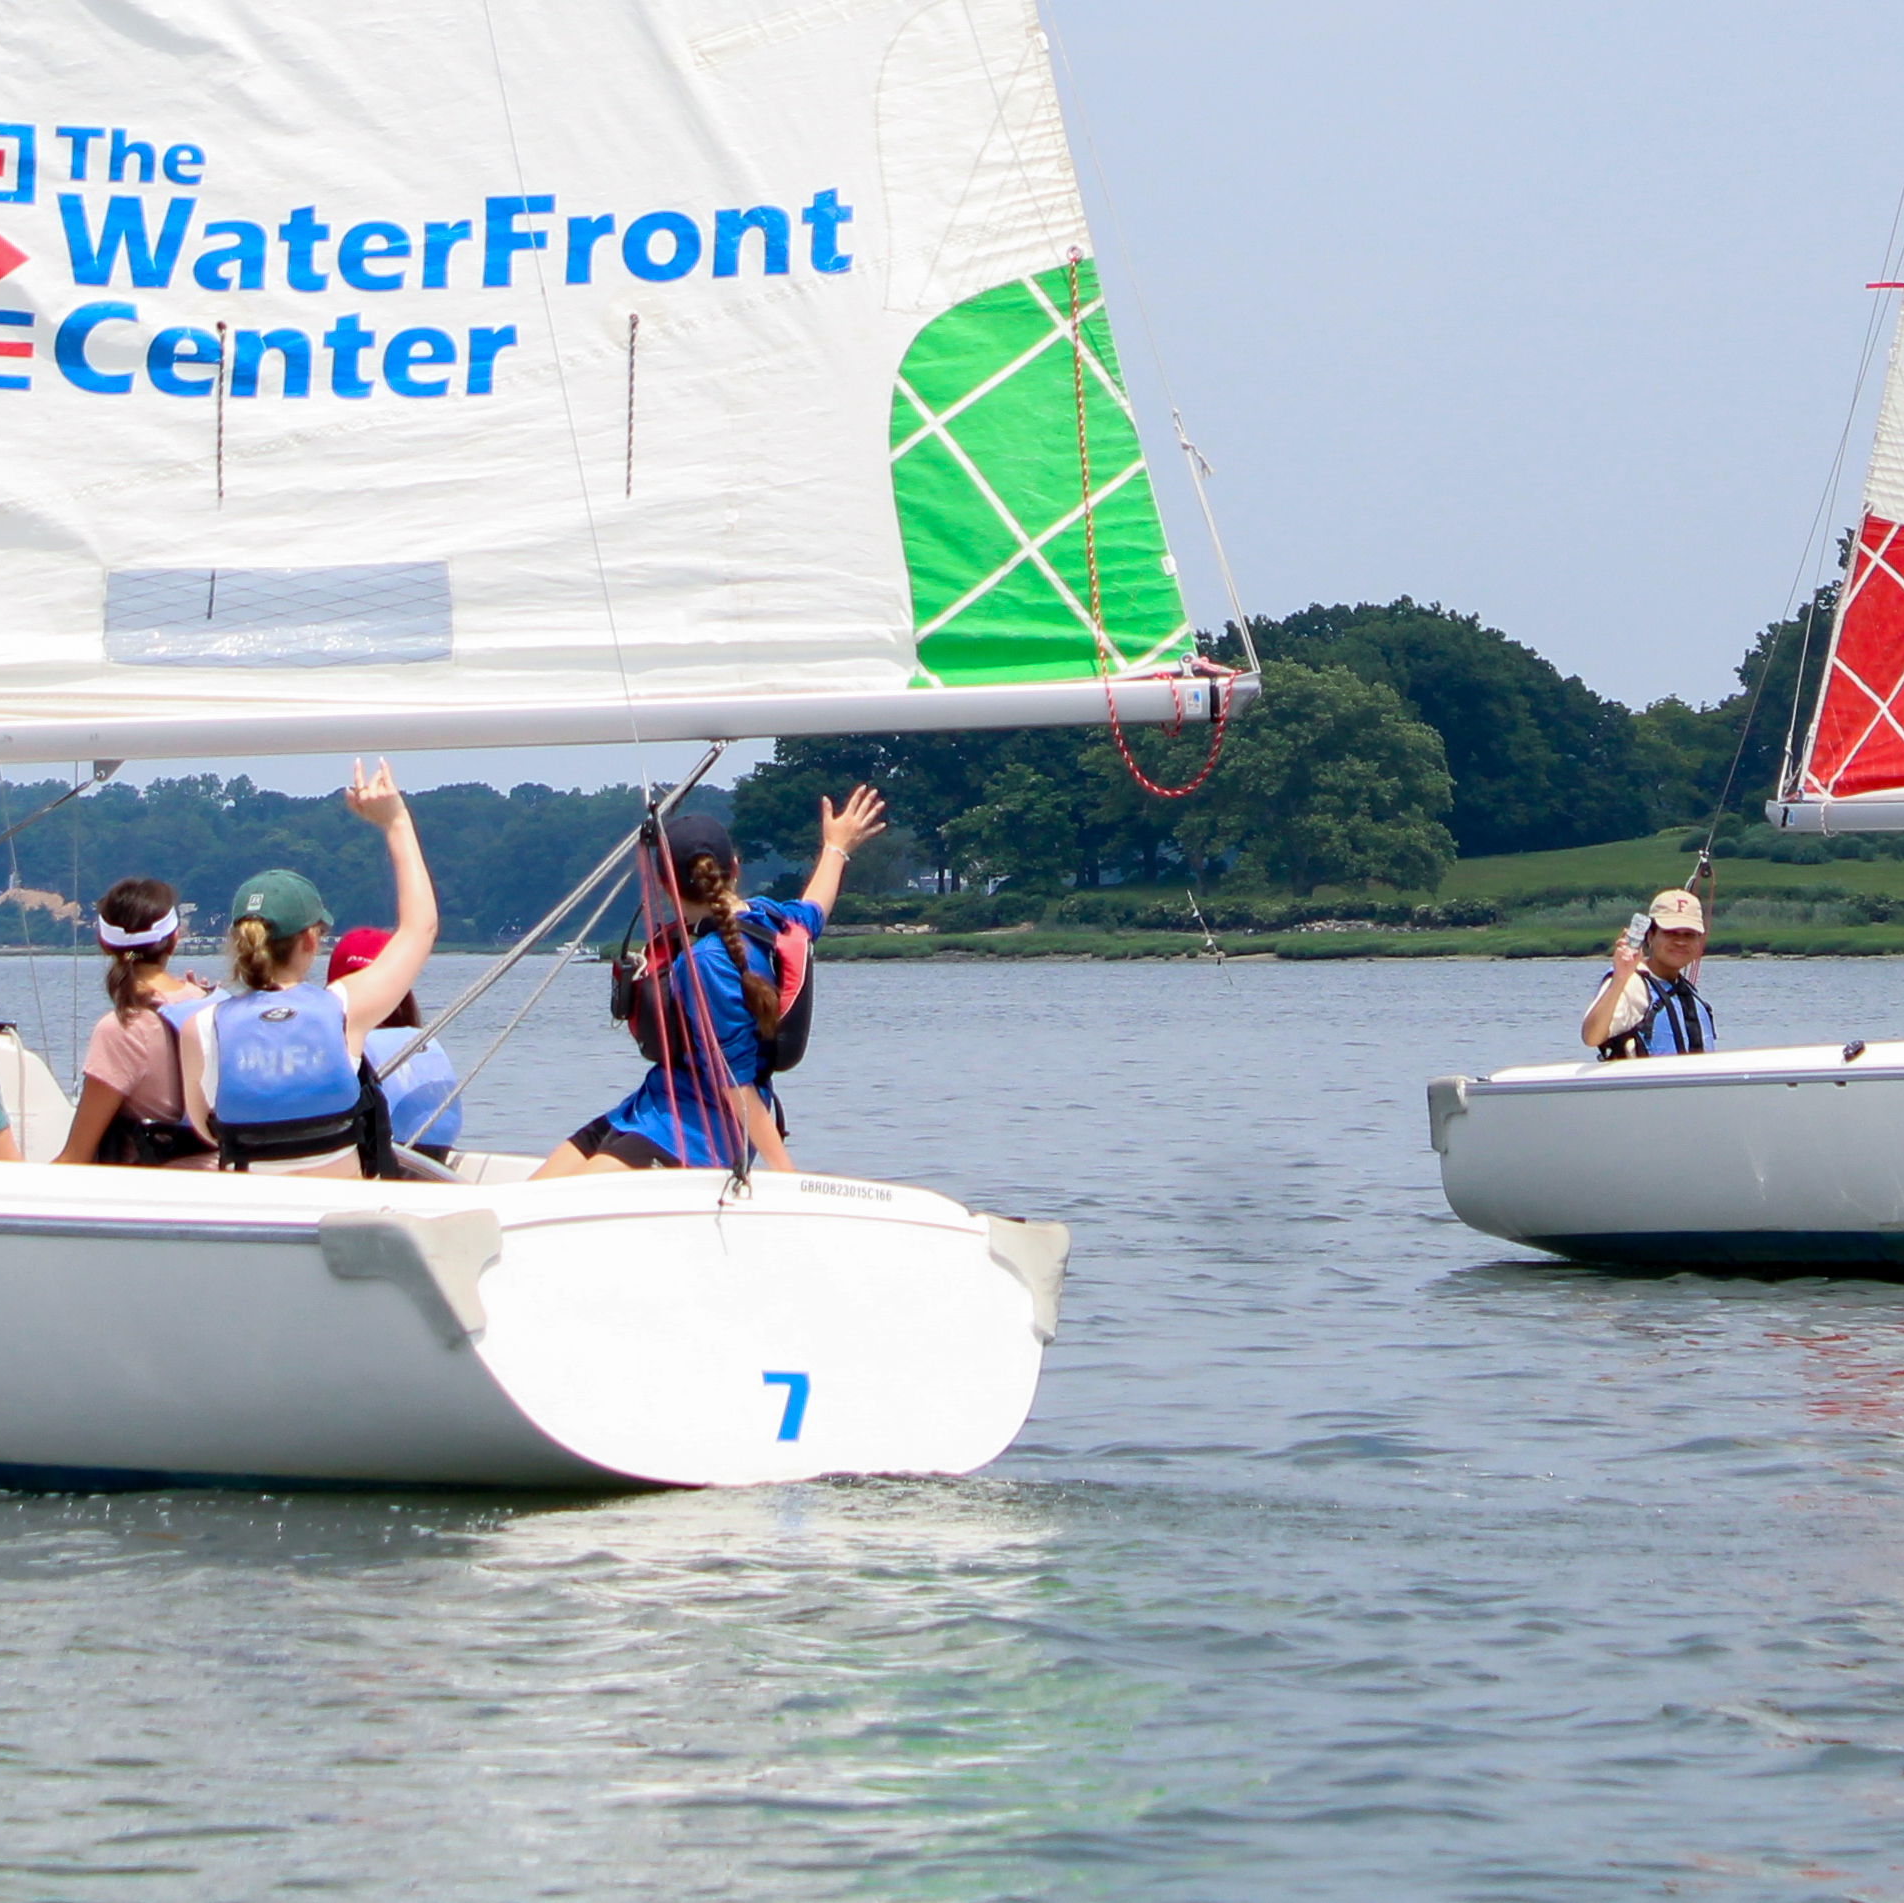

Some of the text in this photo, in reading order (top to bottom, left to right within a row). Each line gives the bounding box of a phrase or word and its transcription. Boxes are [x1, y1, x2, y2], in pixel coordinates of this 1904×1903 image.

[56, 126, 206, 186] The
[56, 187, 856, 293] WaterFront
[54, 301, 518, 401] Center
[1677, 899, 1688, 913] F
[761, 1369, 812, 1442] 7
